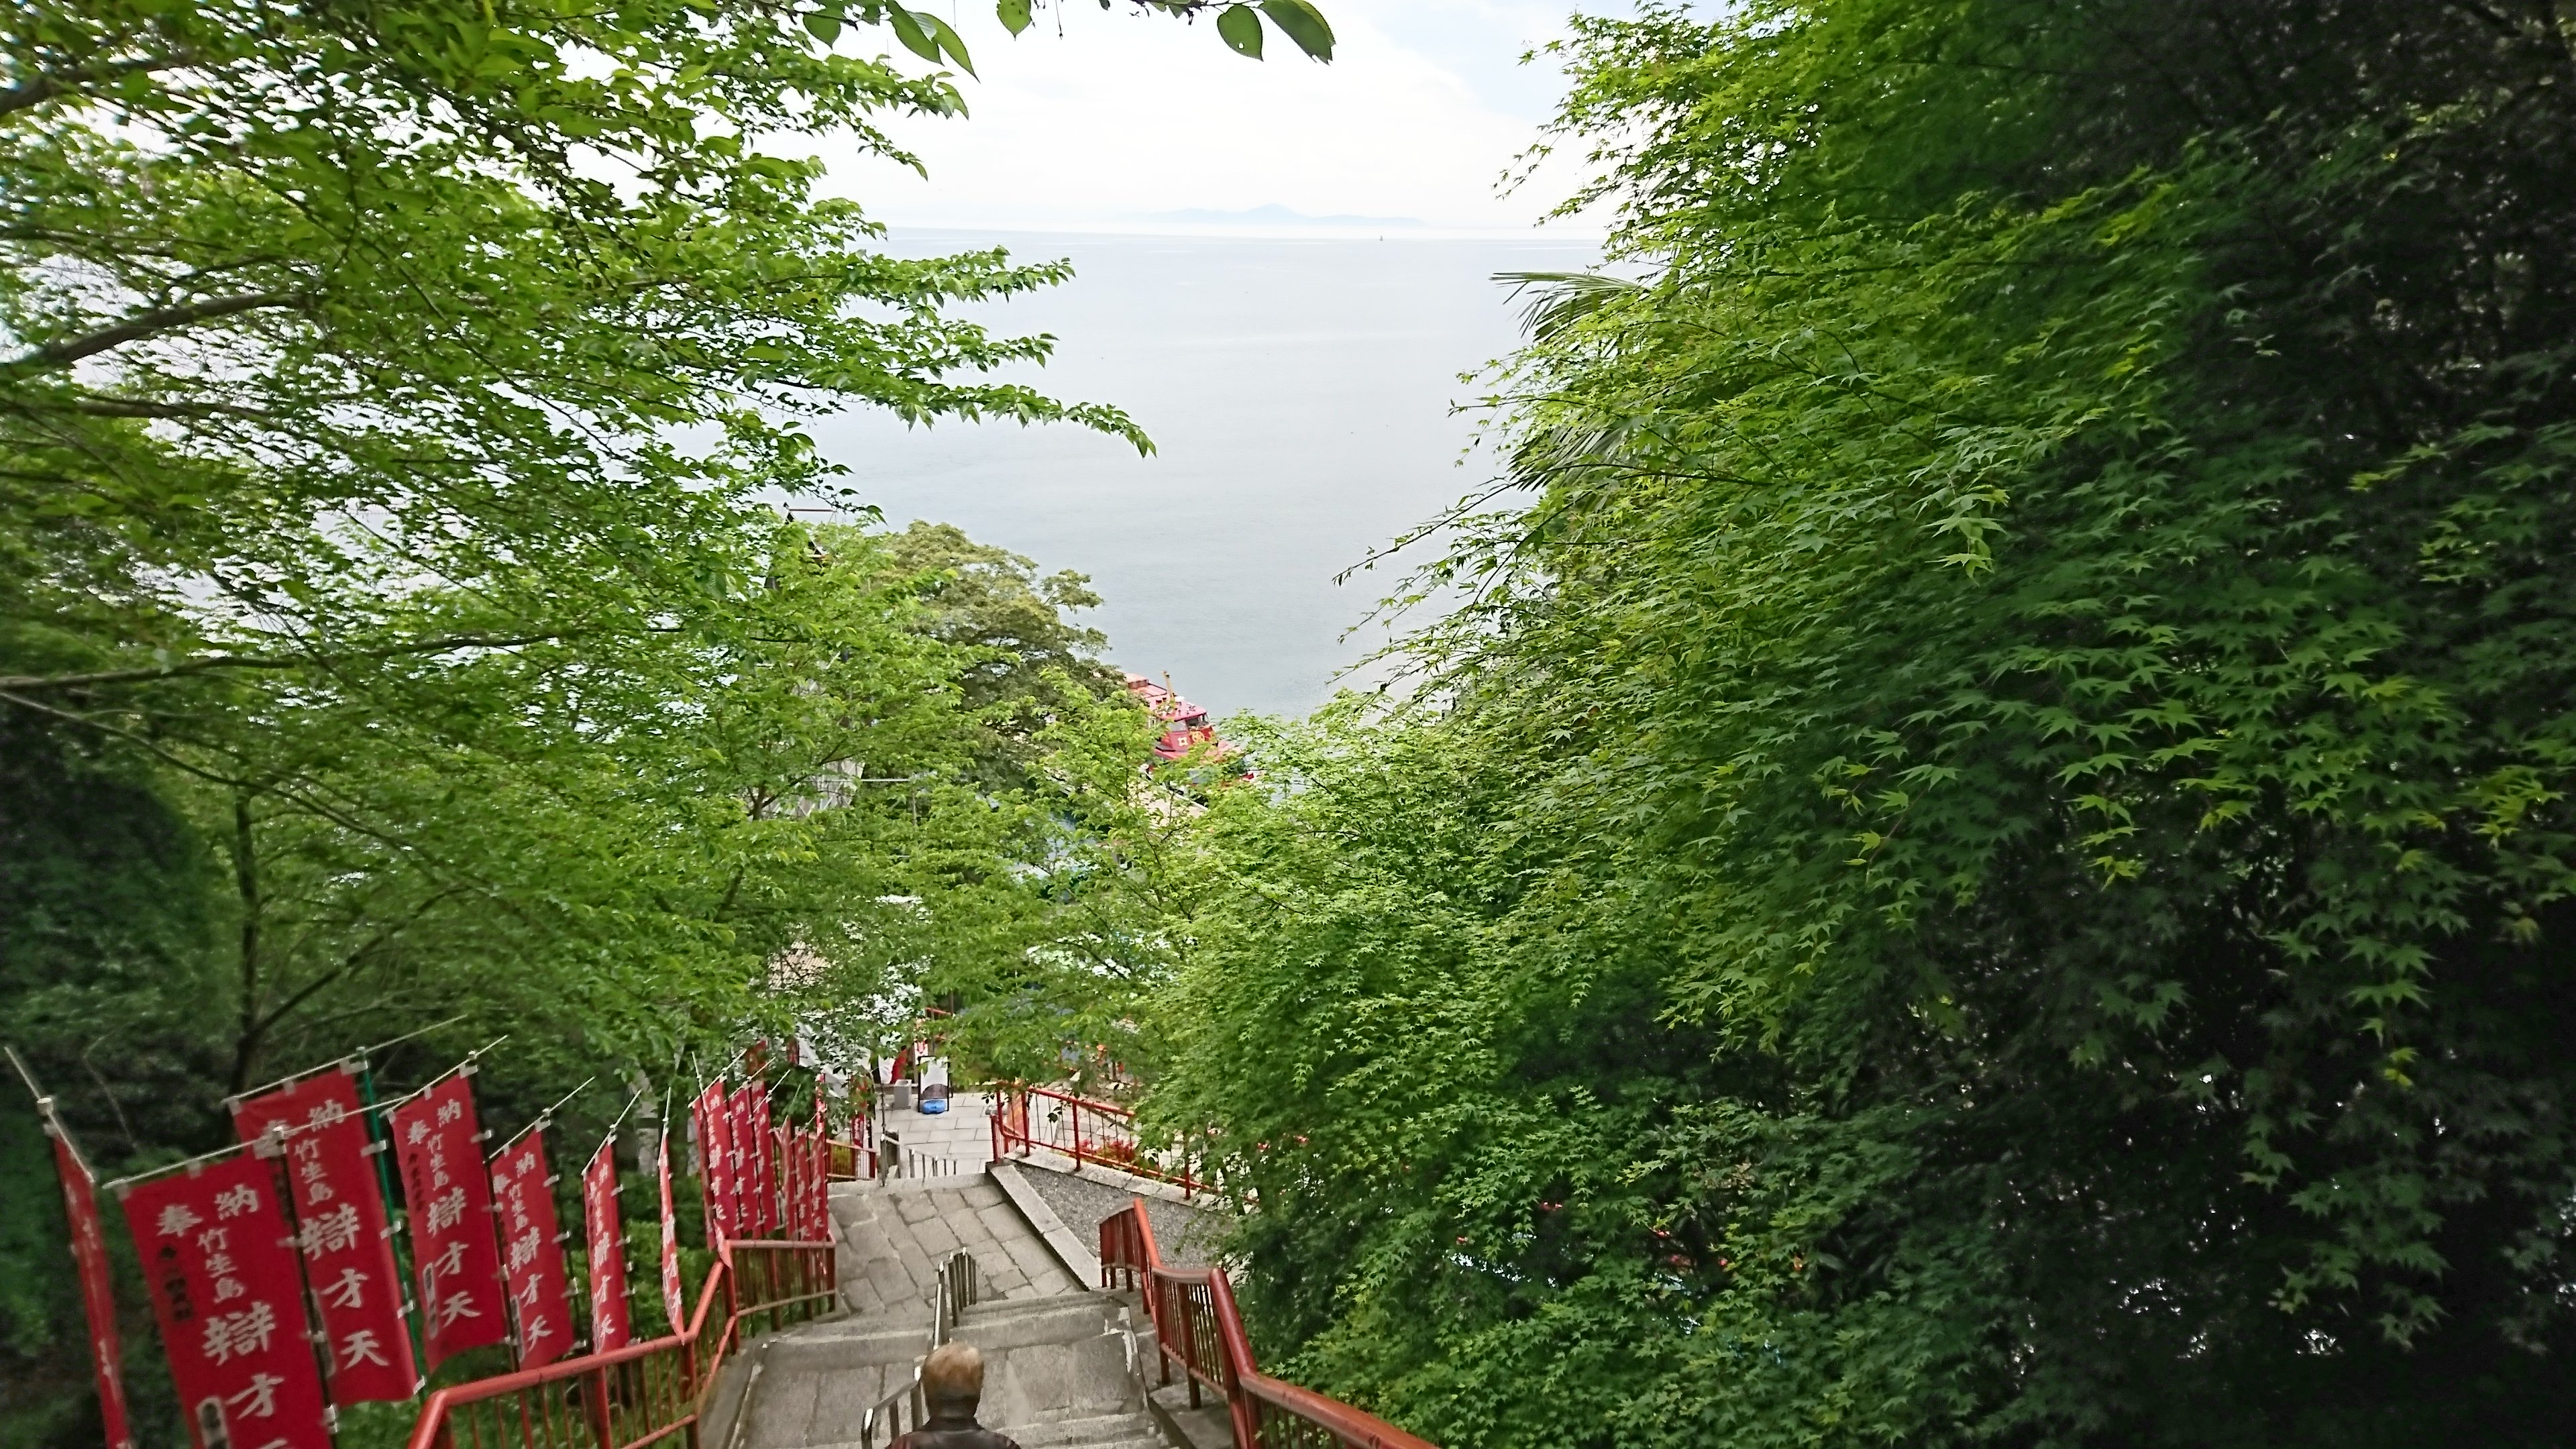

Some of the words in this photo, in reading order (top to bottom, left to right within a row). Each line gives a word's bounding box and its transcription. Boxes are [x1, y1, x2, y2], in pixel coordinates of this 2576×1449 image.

[408, 1099, 462, 1146] 奉納
[156, 1184, 260, 1237] 奉納
[197, 1227, 288, 1449] 竹生島辯才
